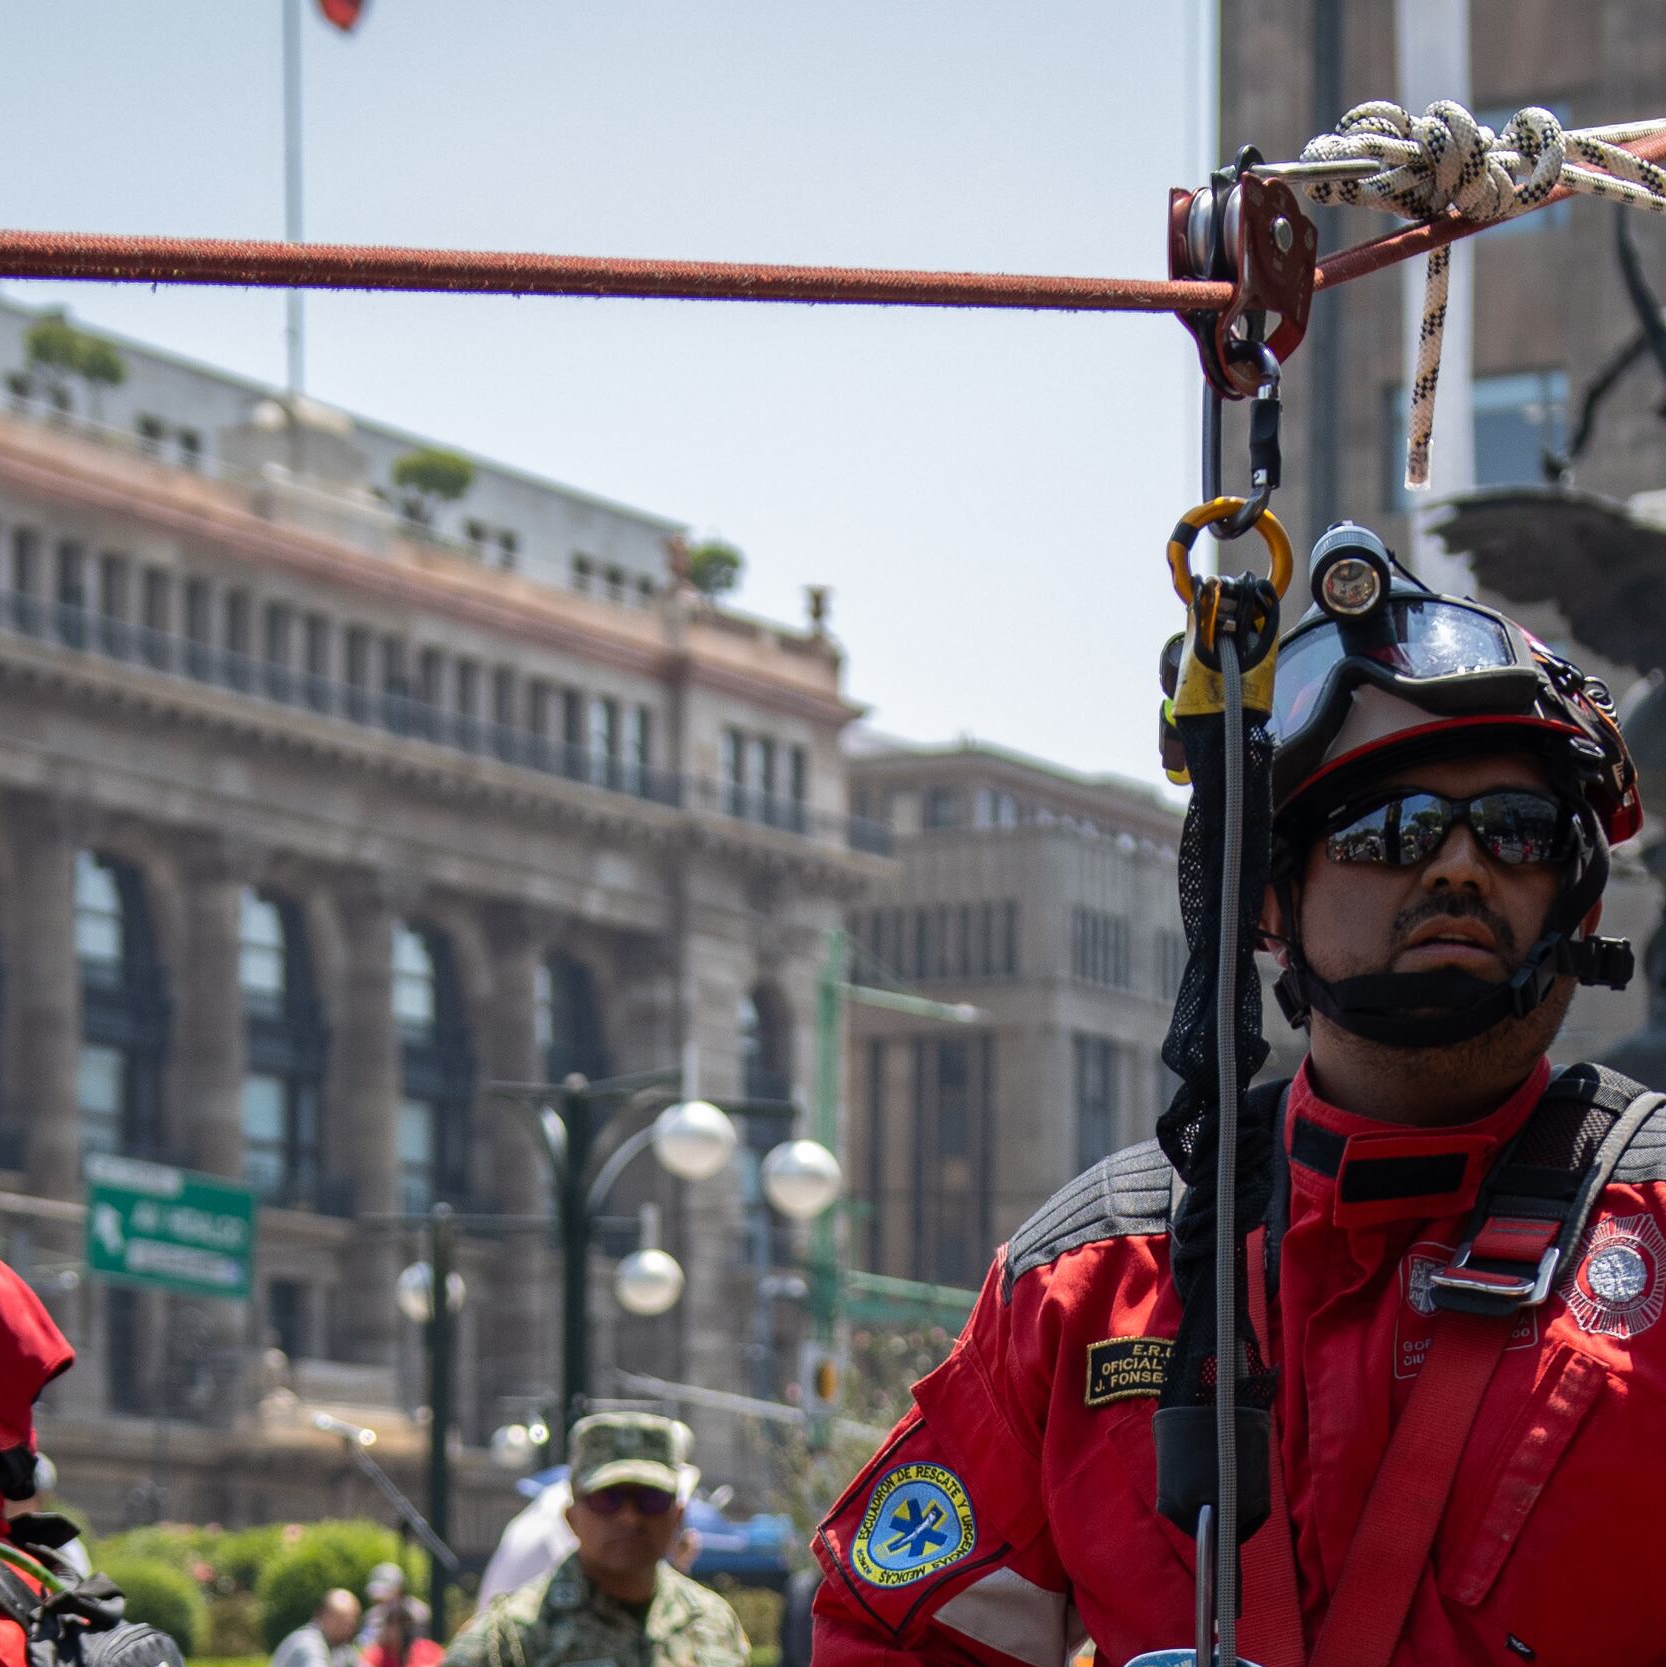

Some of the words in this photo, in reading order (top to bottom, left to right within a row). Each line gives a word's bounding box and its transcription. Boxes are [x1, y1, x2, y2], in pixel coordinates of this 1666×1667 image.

[1101, 1357, 1163, 1376] OFICIAL
[1094, 1379, 1106, 1393] J.
[1110, 1370, 1168, 1388] FONSE
[896, 1466, 913, 1482] DE
[915, 1465, 962, 1500] RESCATE
[857, 1476, 896, 1541] ESCUADRON
[878, 1565, 926, 1584] MEDICAS
